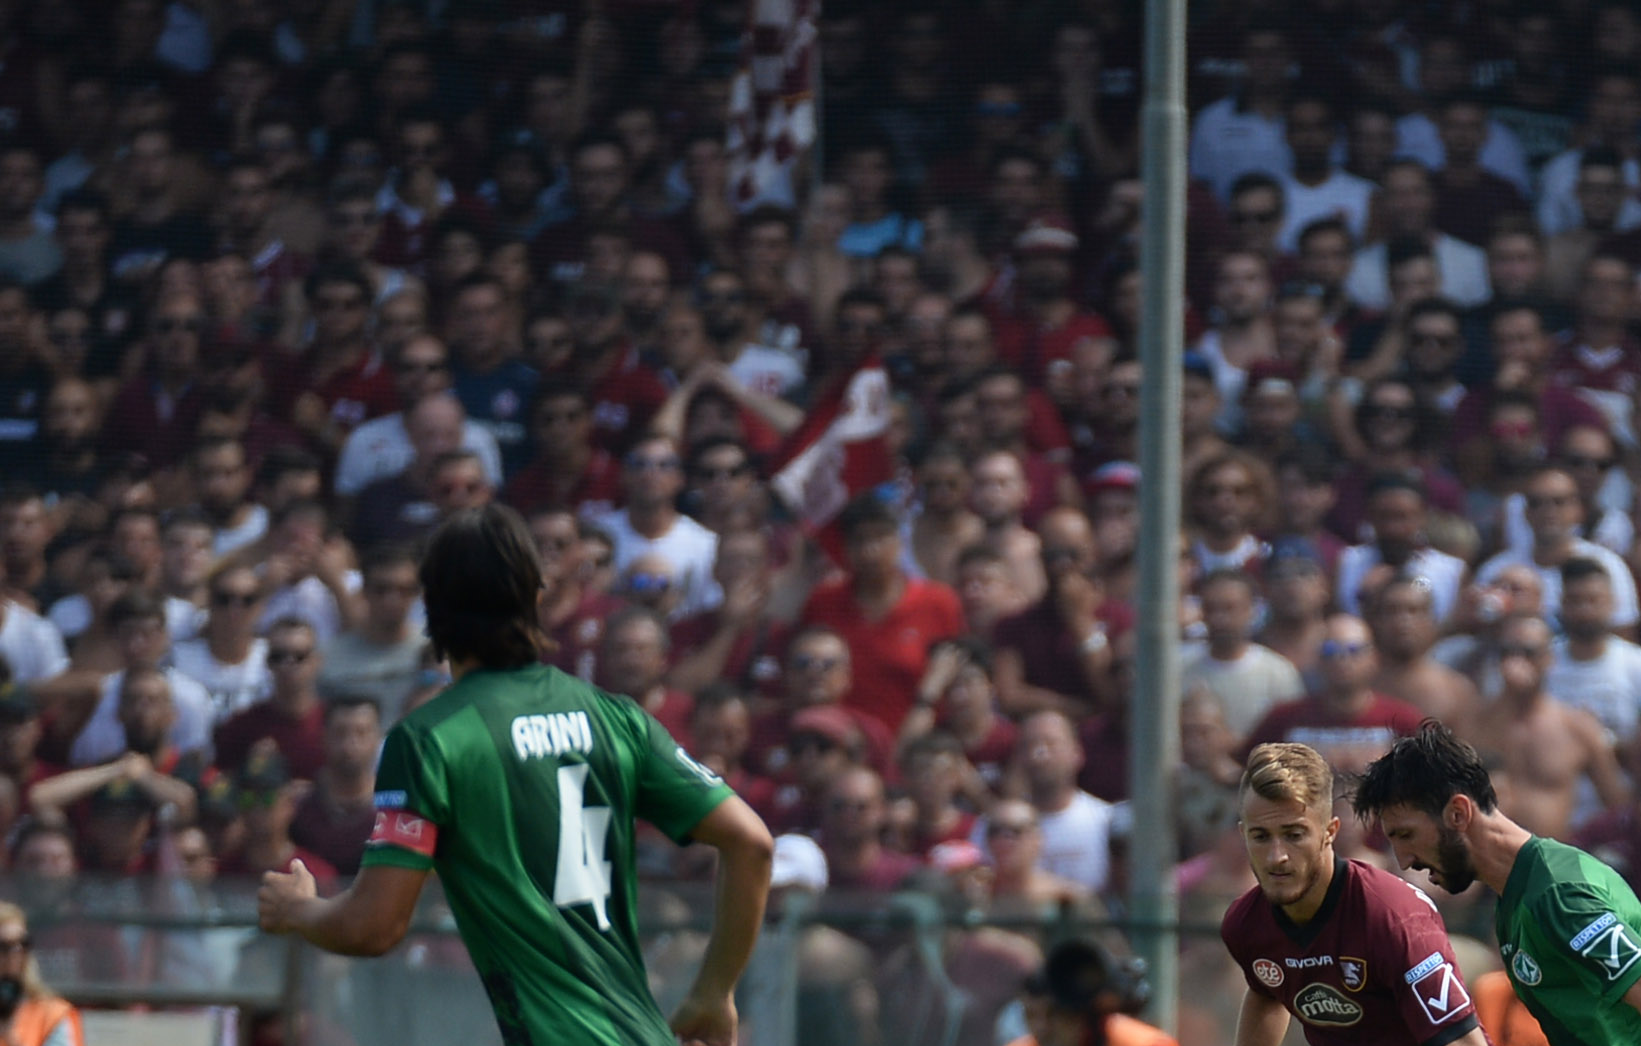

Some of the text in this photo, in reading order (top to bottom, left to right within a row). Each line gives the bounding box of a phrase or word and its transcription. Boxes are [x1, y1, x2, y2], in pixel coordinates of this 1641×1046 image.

[511, 710, 593, 761] ARINI
[554, 763, 612, 931] 4
[1285, 955, 1334, 968] GIVOVA
[1302, 998, 1359, 1016] motta
